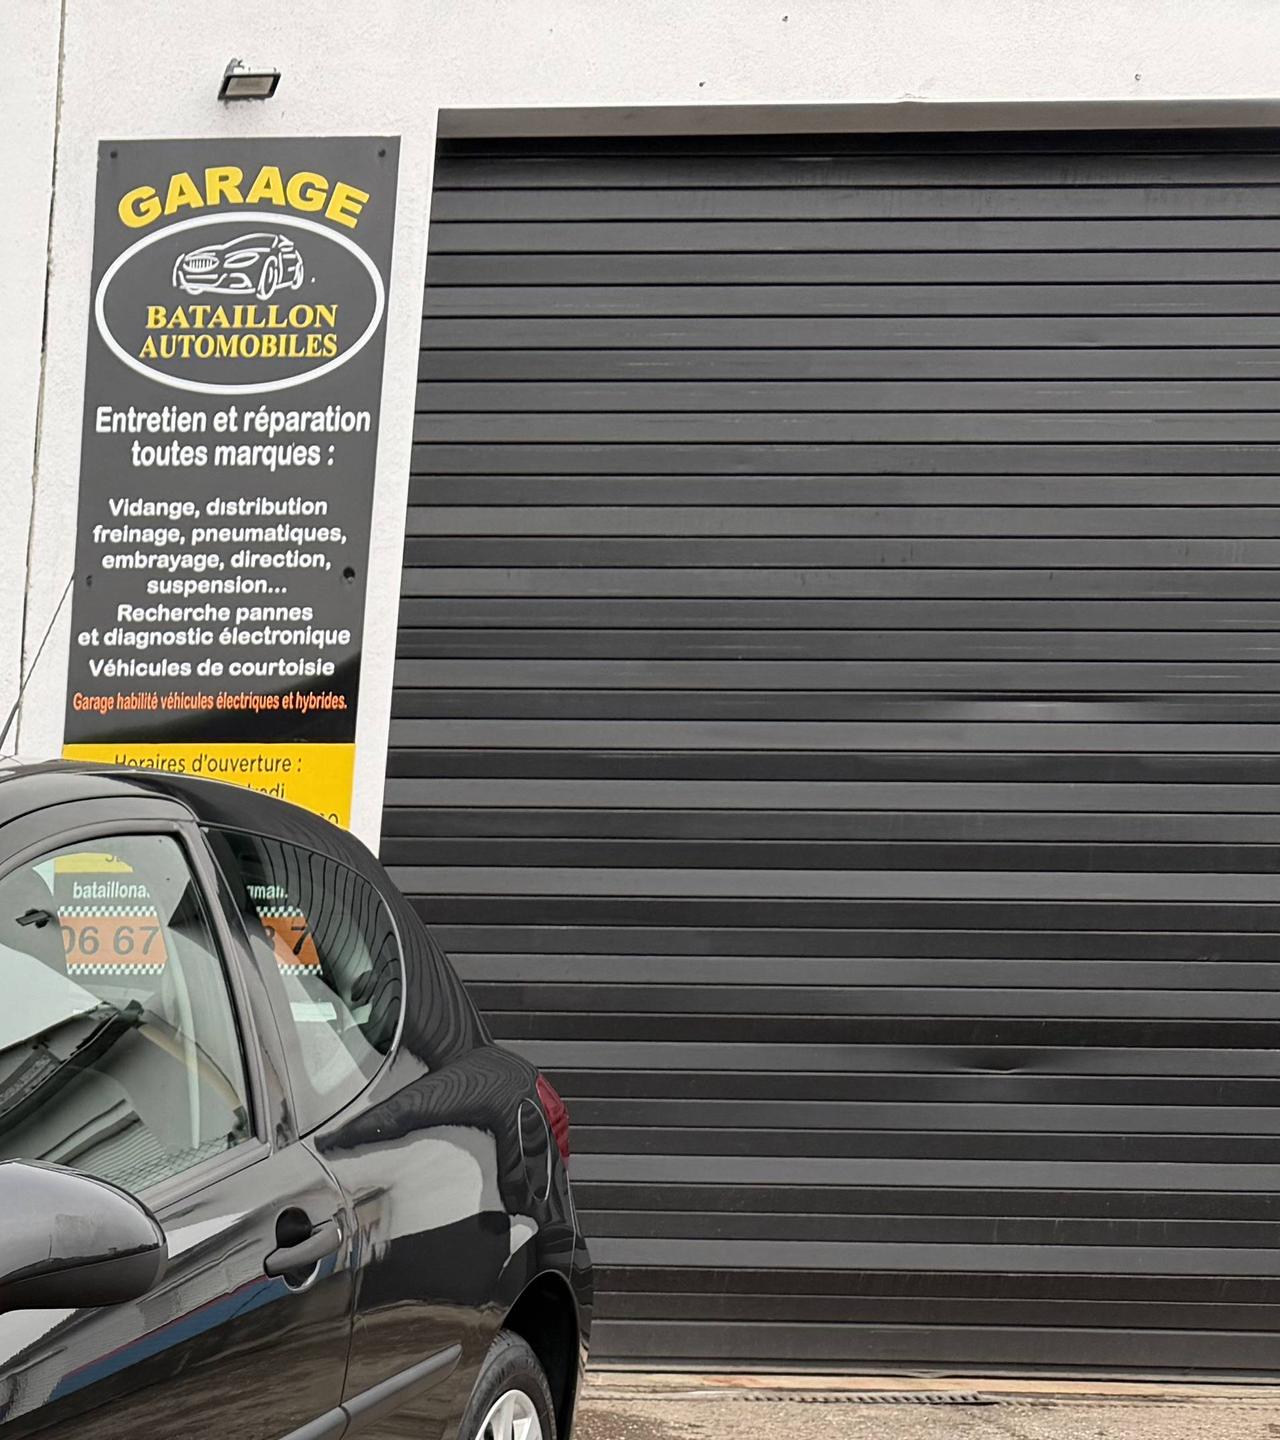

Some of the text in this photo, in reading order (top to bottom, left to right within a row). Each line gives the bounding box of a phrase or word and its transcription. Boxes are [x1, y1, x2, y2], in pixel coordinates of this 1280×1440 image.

[118, 165, 370, 229] GARAGE
[145, 304, 338, 330] BATAILLON
[139, 334, 338, 359] AUTOMOBILES
[95, 404, 371, 439] Entretien et réparation
[131, 439, 208, 467] toutes
[214, 444, 321, 473] marques
[108, 496, 328, 520] Vidange, distribution
[92, 523, 347, 547] freinage, pneumatiques,
[101, 549, 332, 573] embrayage, direction,
[146, 575, 287, 598] suspension...
[116, 603, 314, 627] Recherche pannes
[77, 624, 351, 651] et diagnostic électronique
[88, 657, 335, 678] Véhicules de courtoisie
[73, 691, 347, 715] Garage habilité véhicules électriques et hybrides.
[115, 754, 186, 773] Horaires
[192, 753, 292, 773] d'ouverture
[113, 925, 160, 956] 67
